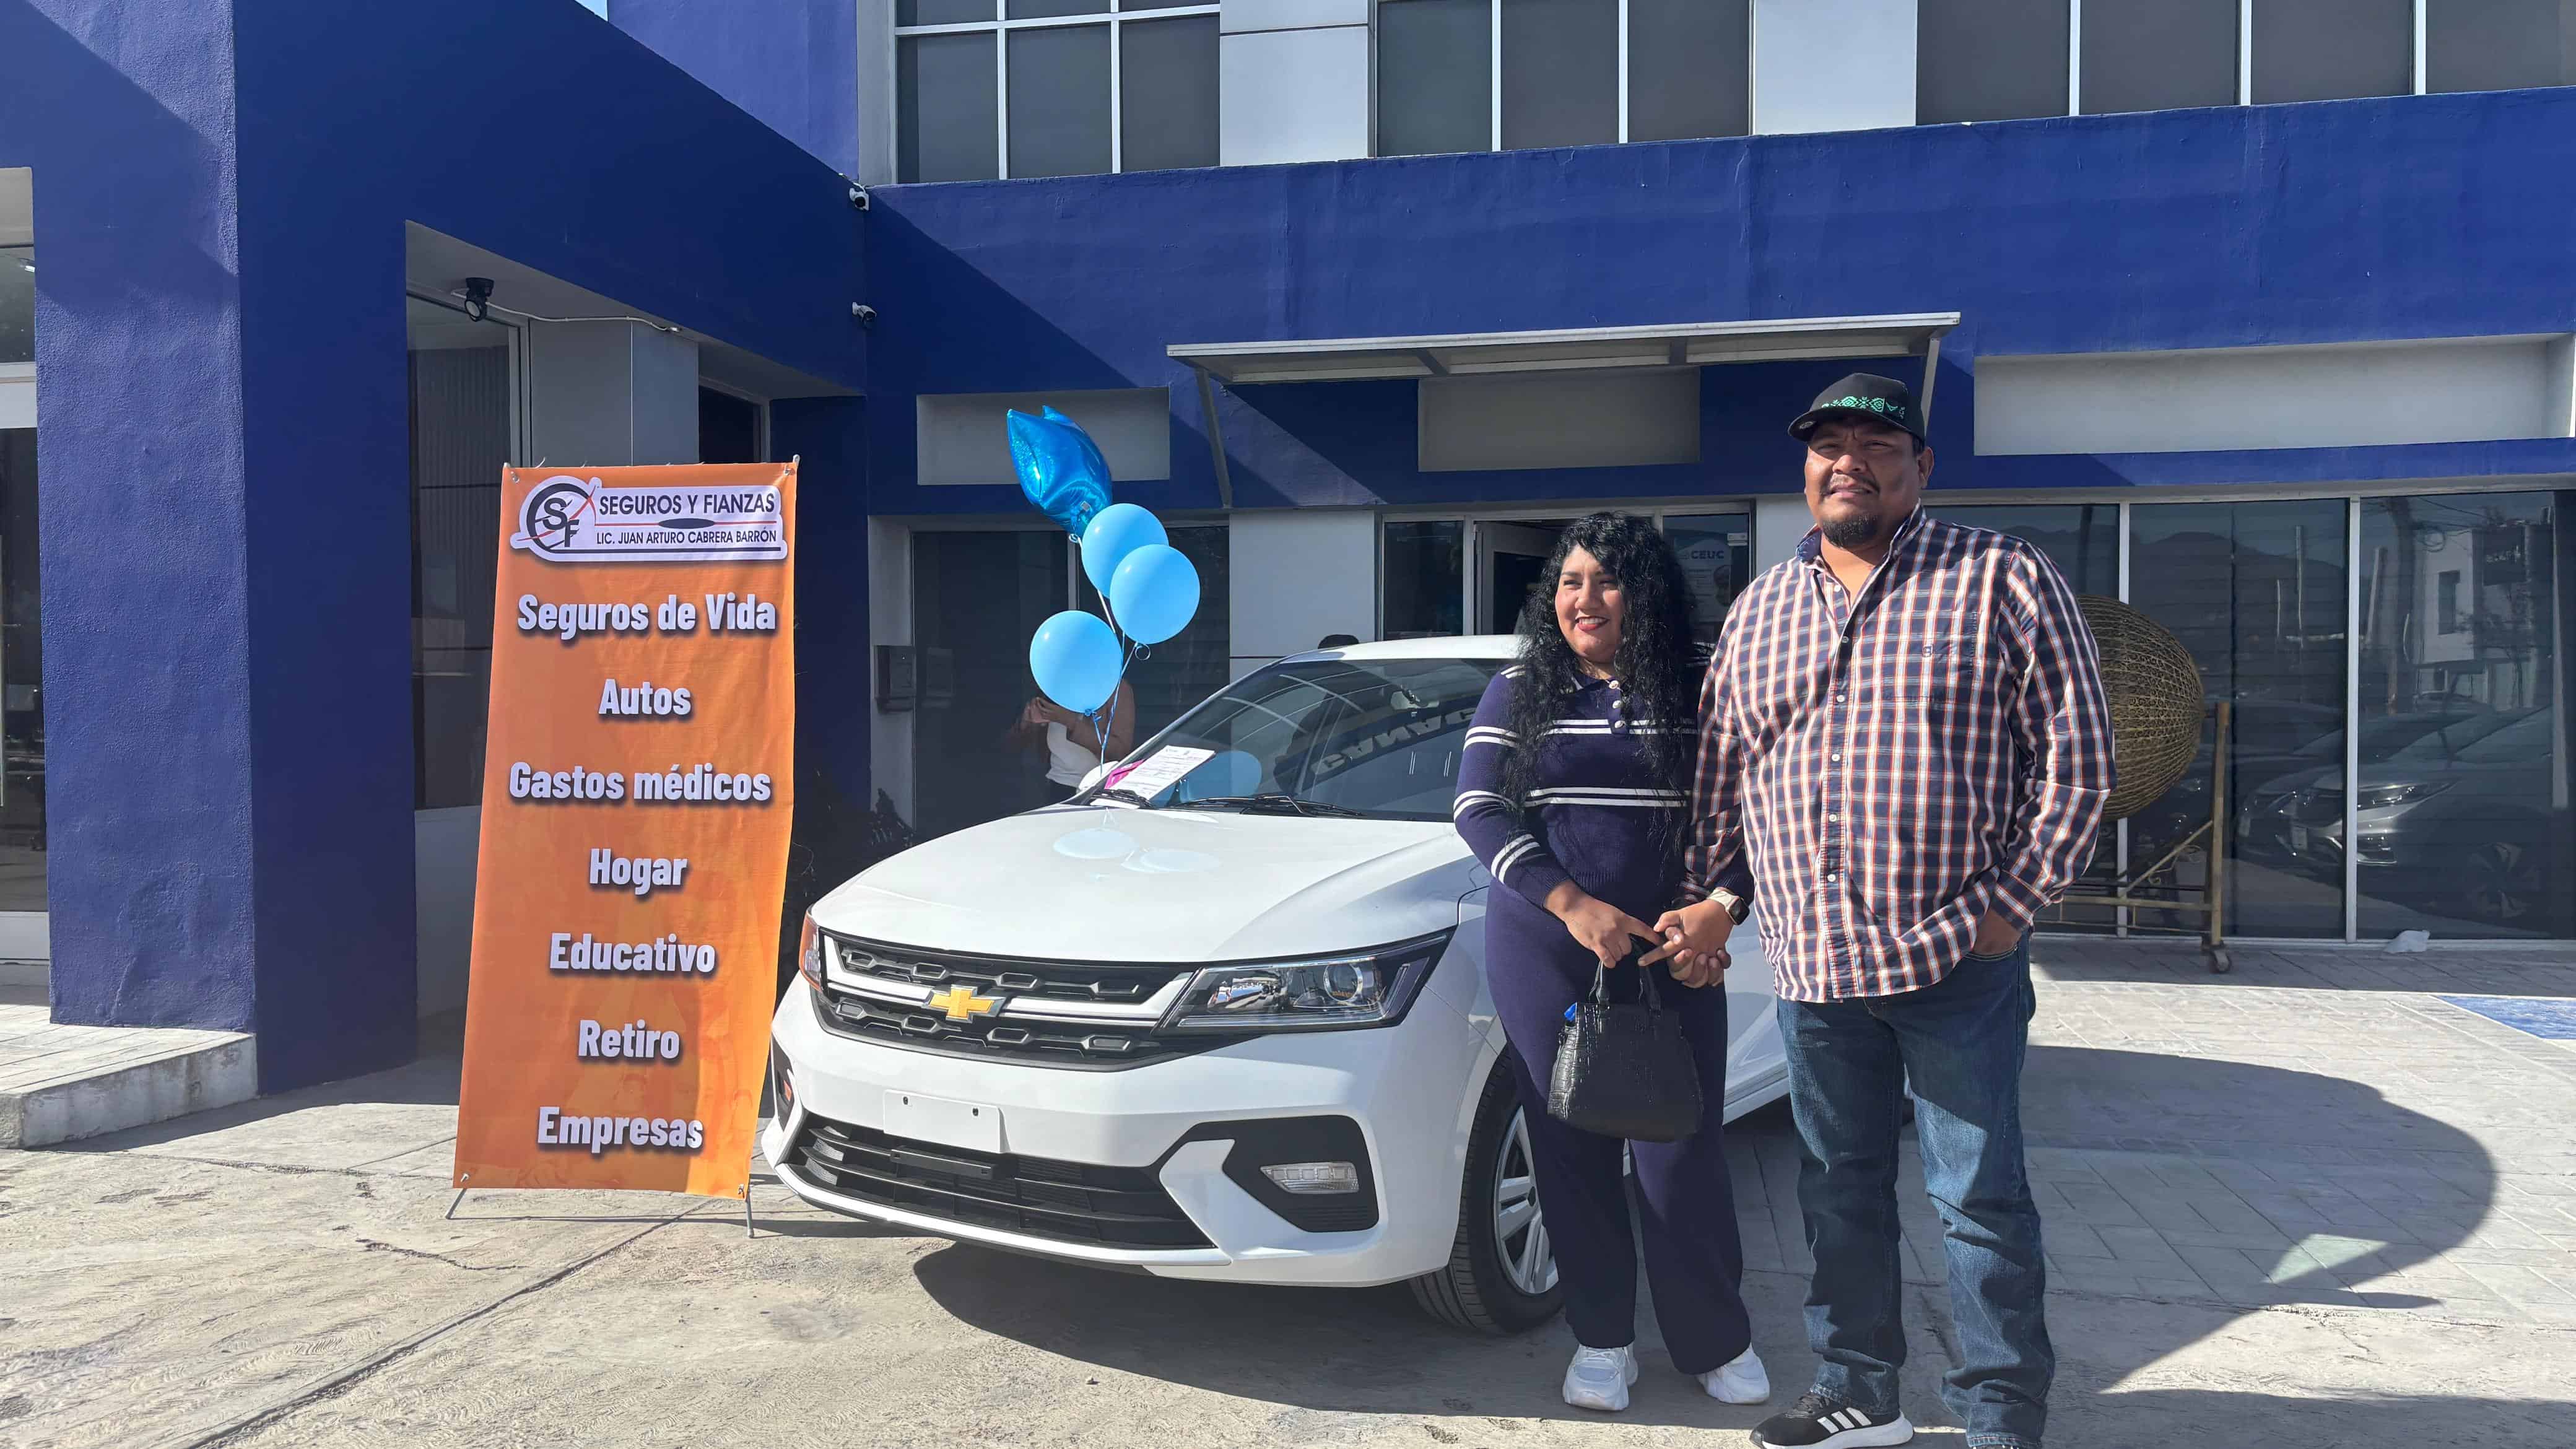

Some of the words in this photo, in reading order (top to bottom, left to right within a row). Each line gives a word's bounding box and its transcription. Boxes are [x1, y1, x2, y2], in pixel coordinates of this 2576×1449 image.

[599, 495, 682, 515] SEGUROS
[687, 494, 698, 514] Y
[703, 493, 775, 514] FIANZAS
[596, 533, 616, 545] LIC.
[619, 533, 644, 544] JUAN
[646, 531, 685, 544] ARTURO
[687, 530, 734, 544] CABRERA
[736, 526, 777, 542] BARRÓN
[518, 593, 649, 640] Seguros
[658, 594, 696, 630] de
[705, 591, 777, 630] Vida
[598, 678, 691, 715] Autos
[509, 762, 624, 799] Gastos
[633, 762, 771, 801] médicos
[589, 848, 688, 895] Hogar
[549, 932, 716, 973] Educativo
[578, 1019, 680, 1059] Retiro
[537, 1106, 703, 1154] Empresas
